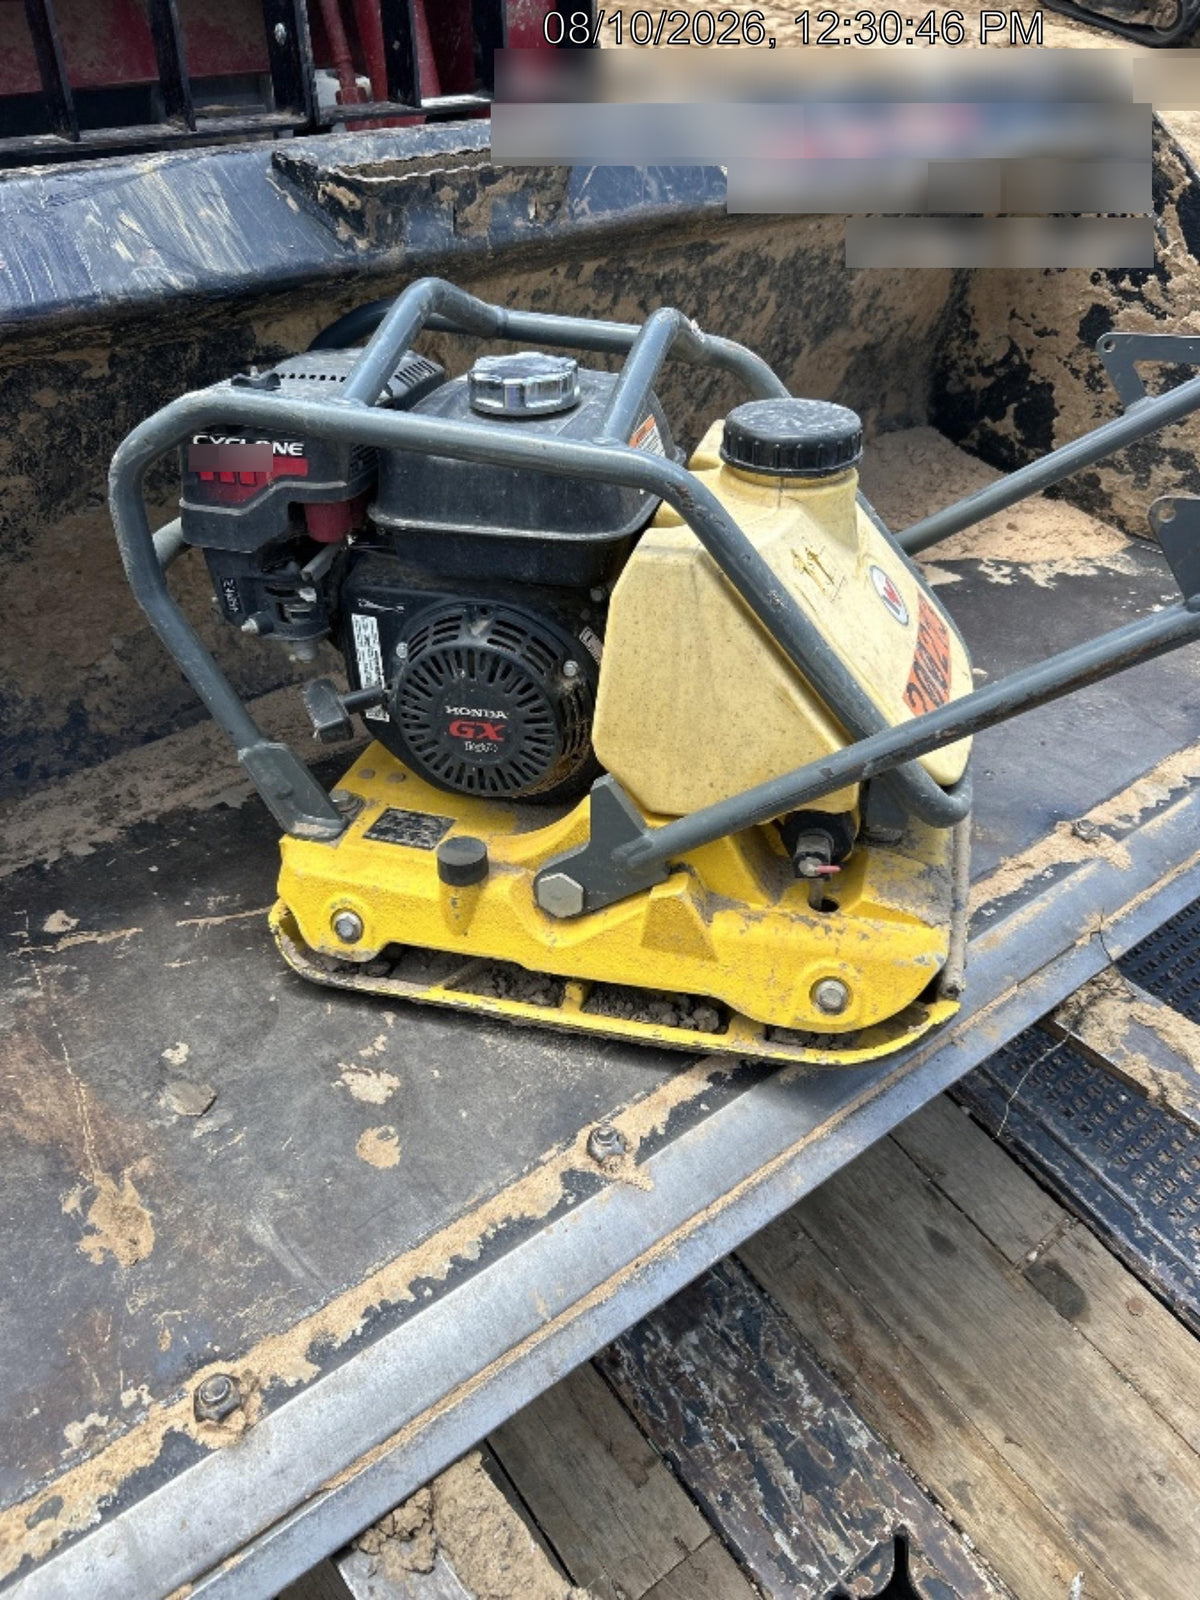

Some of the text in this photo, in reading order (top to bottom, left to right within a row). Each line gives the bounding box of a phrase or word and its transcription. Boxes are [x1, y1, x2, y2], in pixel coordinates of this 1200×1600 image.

[193, 435, 305, 455] CYCNE
[445, 705, 508, 719] HONDA
[449, 720, 505, 741] GX
